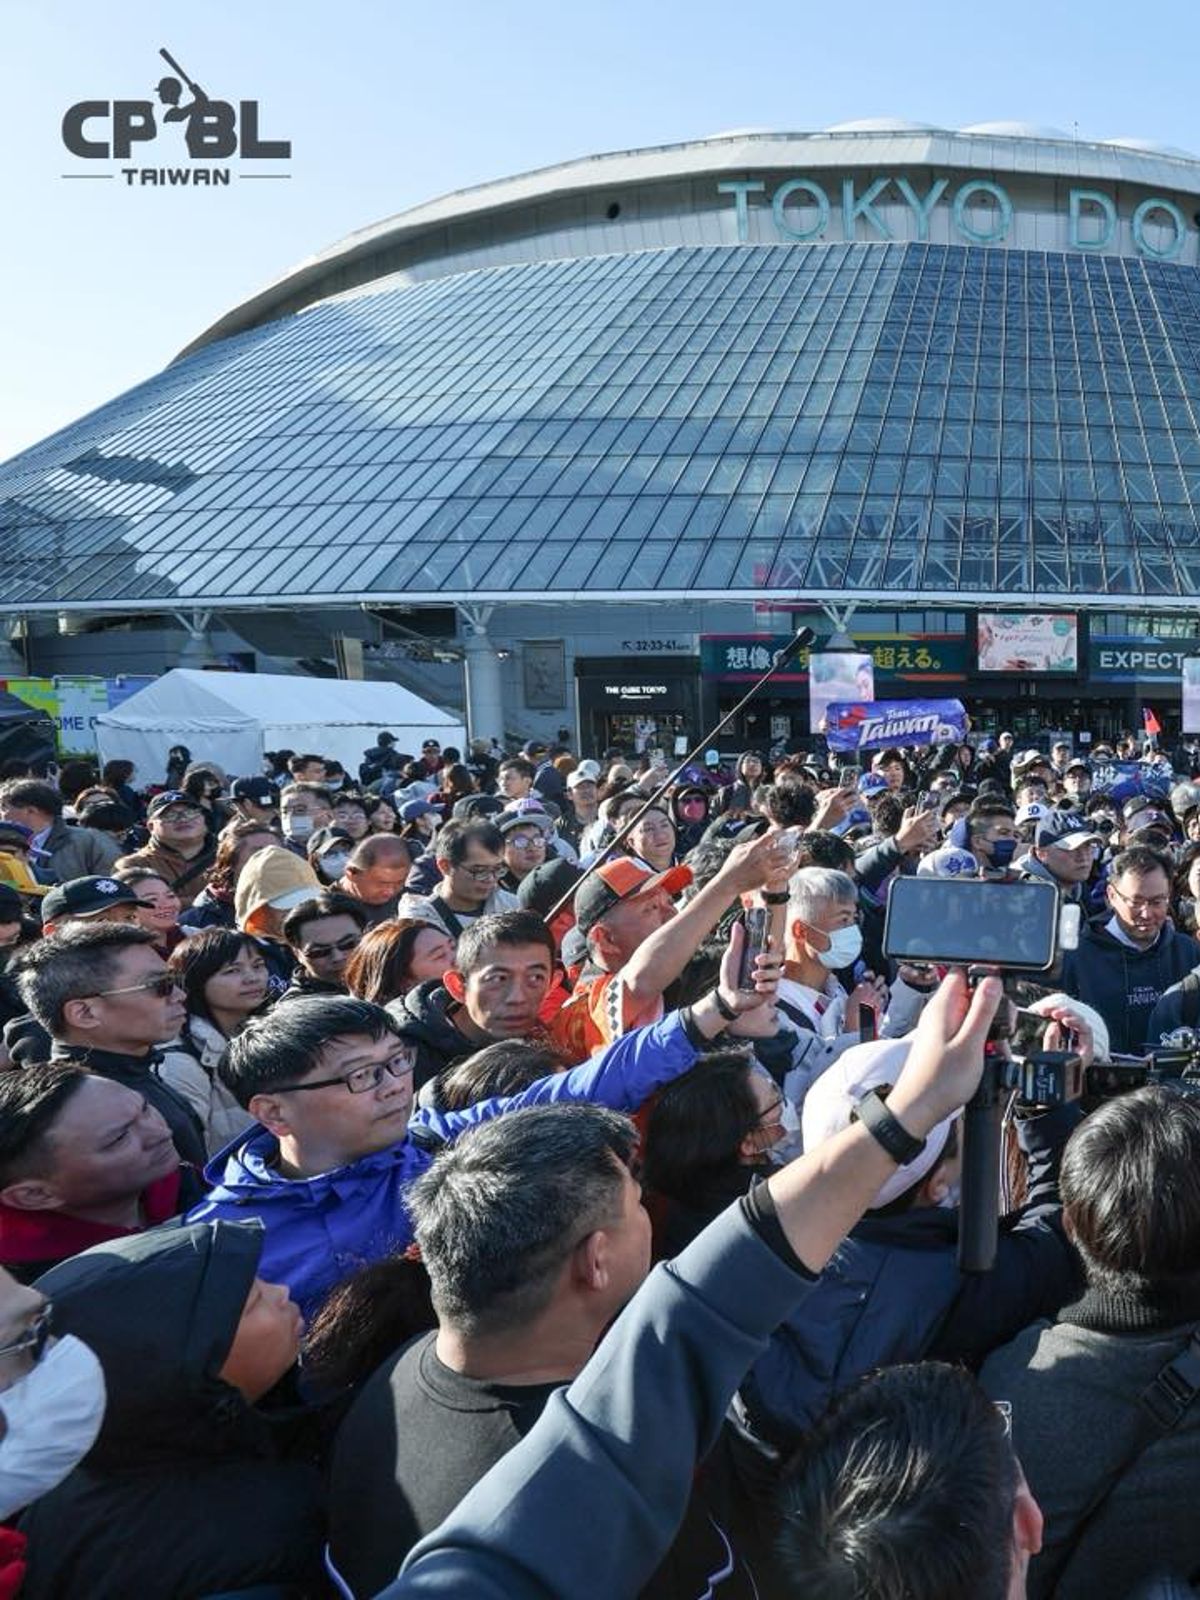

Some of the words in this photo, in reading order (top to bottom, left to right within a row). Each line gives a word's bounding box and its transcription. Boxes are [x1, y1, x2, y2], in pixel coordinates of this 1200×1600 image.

[717, 177, 1014, 243] TOKYO
[1100, 651, 1185, 669] EXPECT
[605, 686, 619, 694] THE
[641, 686, 667, 694] TOKYO
[858, 714, 940, 746] Taiwan
